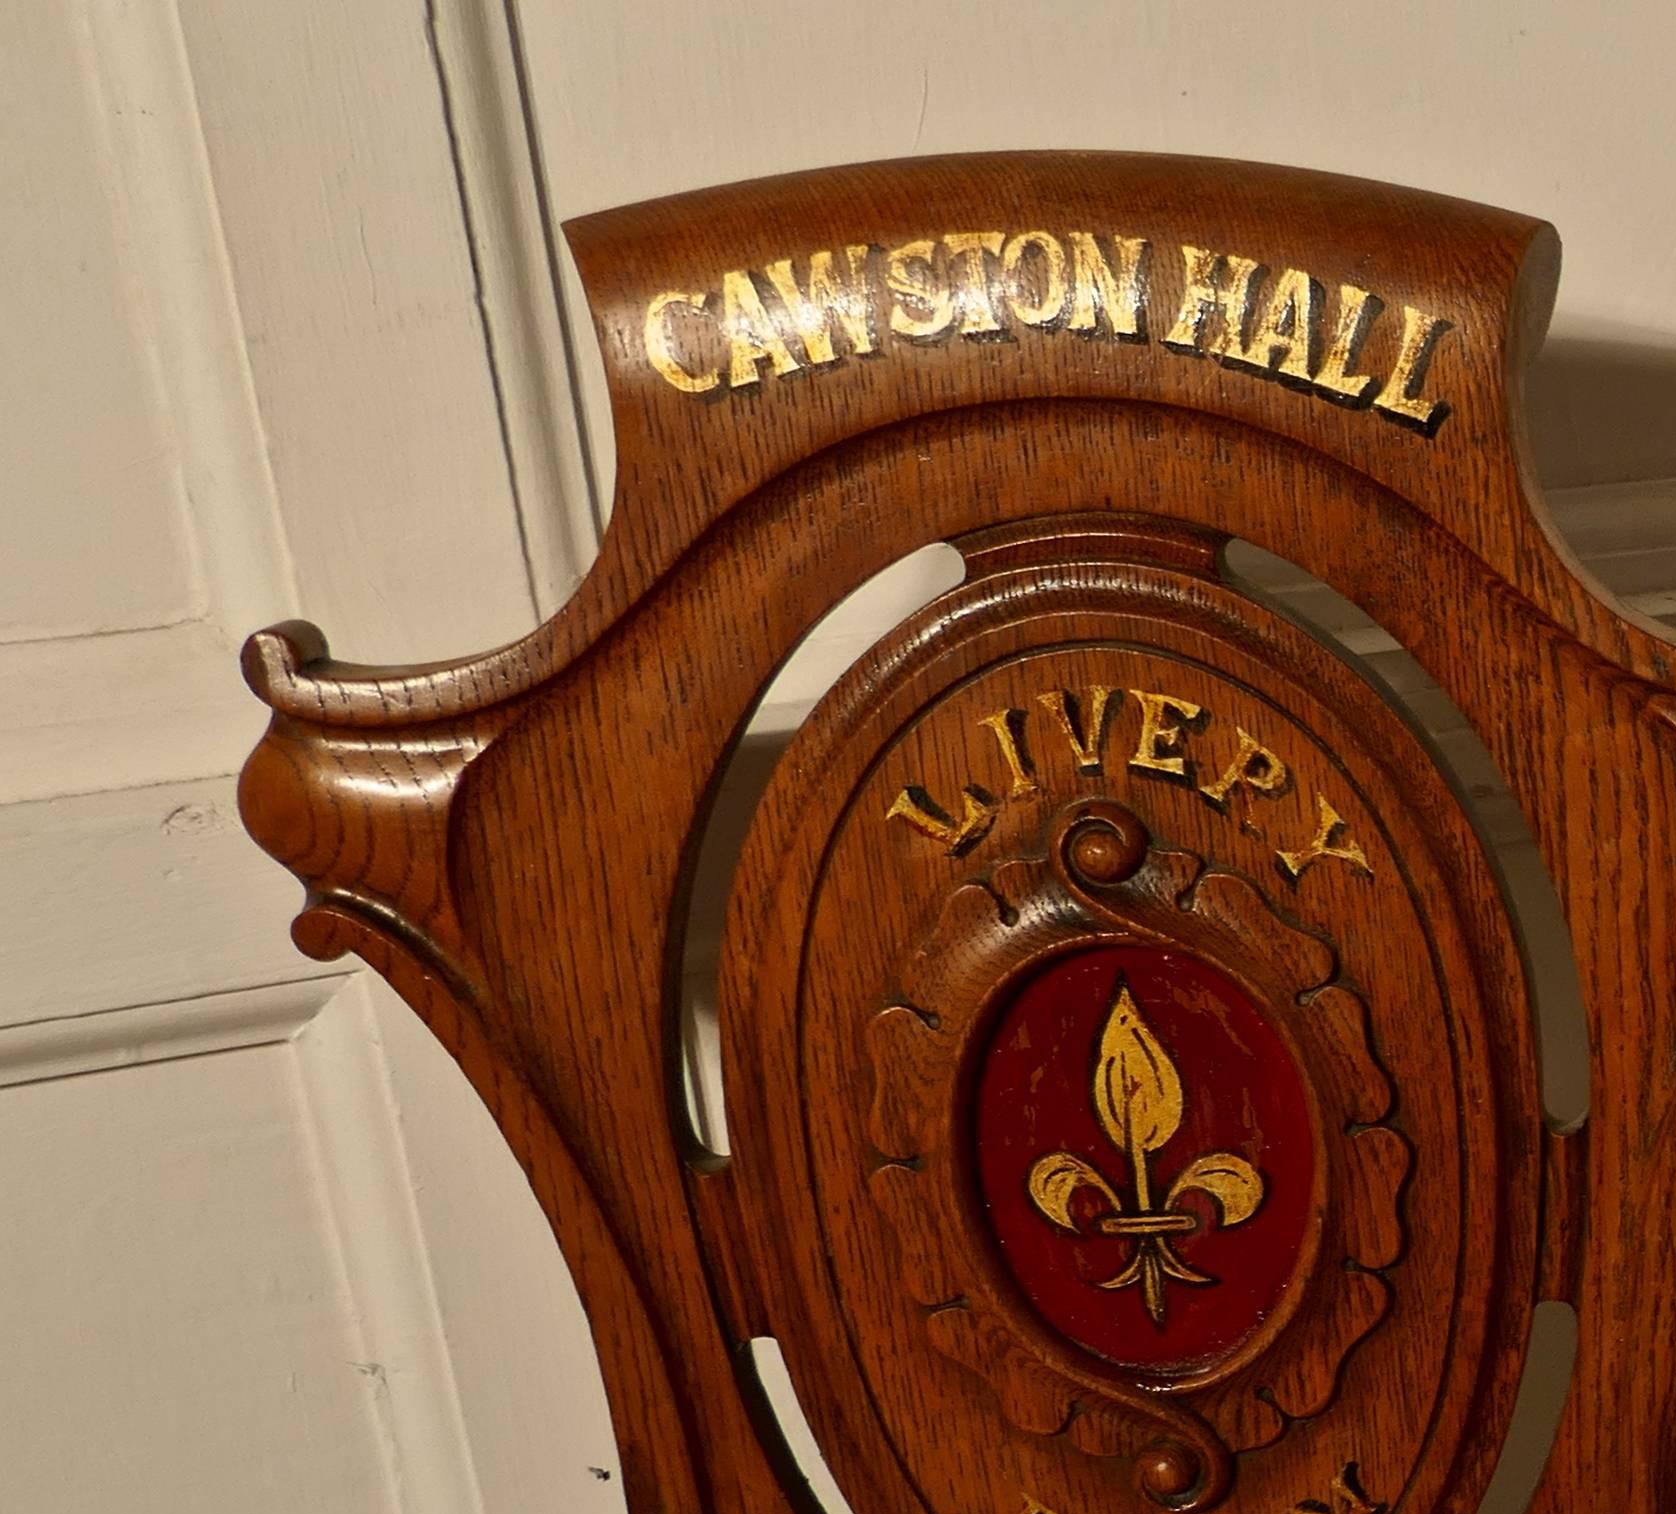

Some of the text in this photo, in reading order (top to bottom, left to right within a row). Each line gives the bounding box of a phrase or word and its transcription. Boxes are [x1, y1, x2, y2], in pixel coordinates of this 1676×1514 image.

[642, 230, 1453, 437] CAWSTON HALL
[885, 685, 1374, 880] LIVERY
